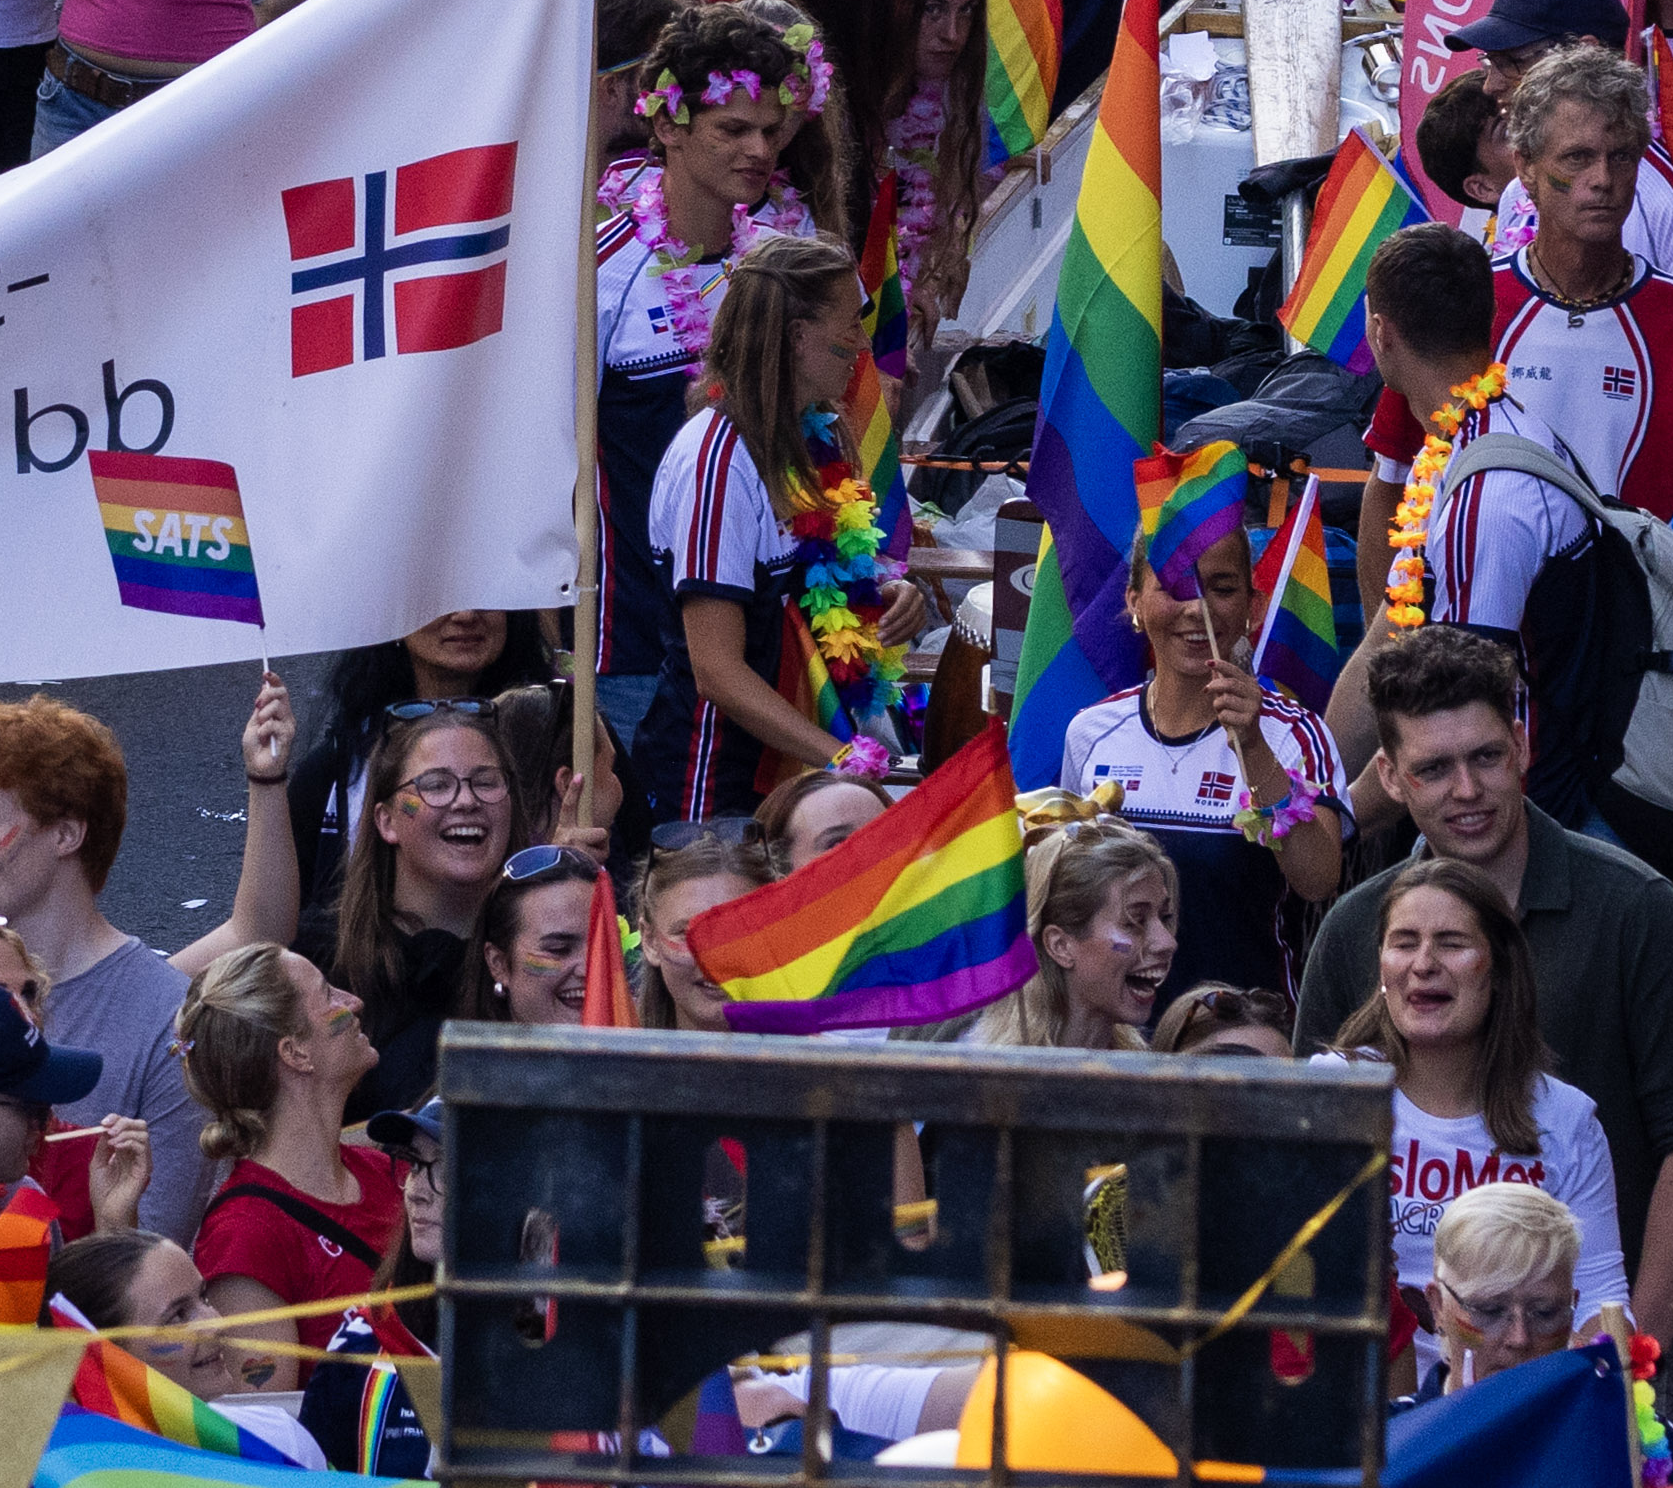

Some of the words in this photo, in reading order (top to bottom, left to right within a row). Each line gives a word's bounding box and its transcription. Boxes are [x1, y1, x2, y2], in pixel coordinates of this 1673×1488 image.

[132, 509, 234, 562] SATS
[1194, 796, 1231, 810] NORWAY
[1389, 1137, 1545, 1207] sloMet
